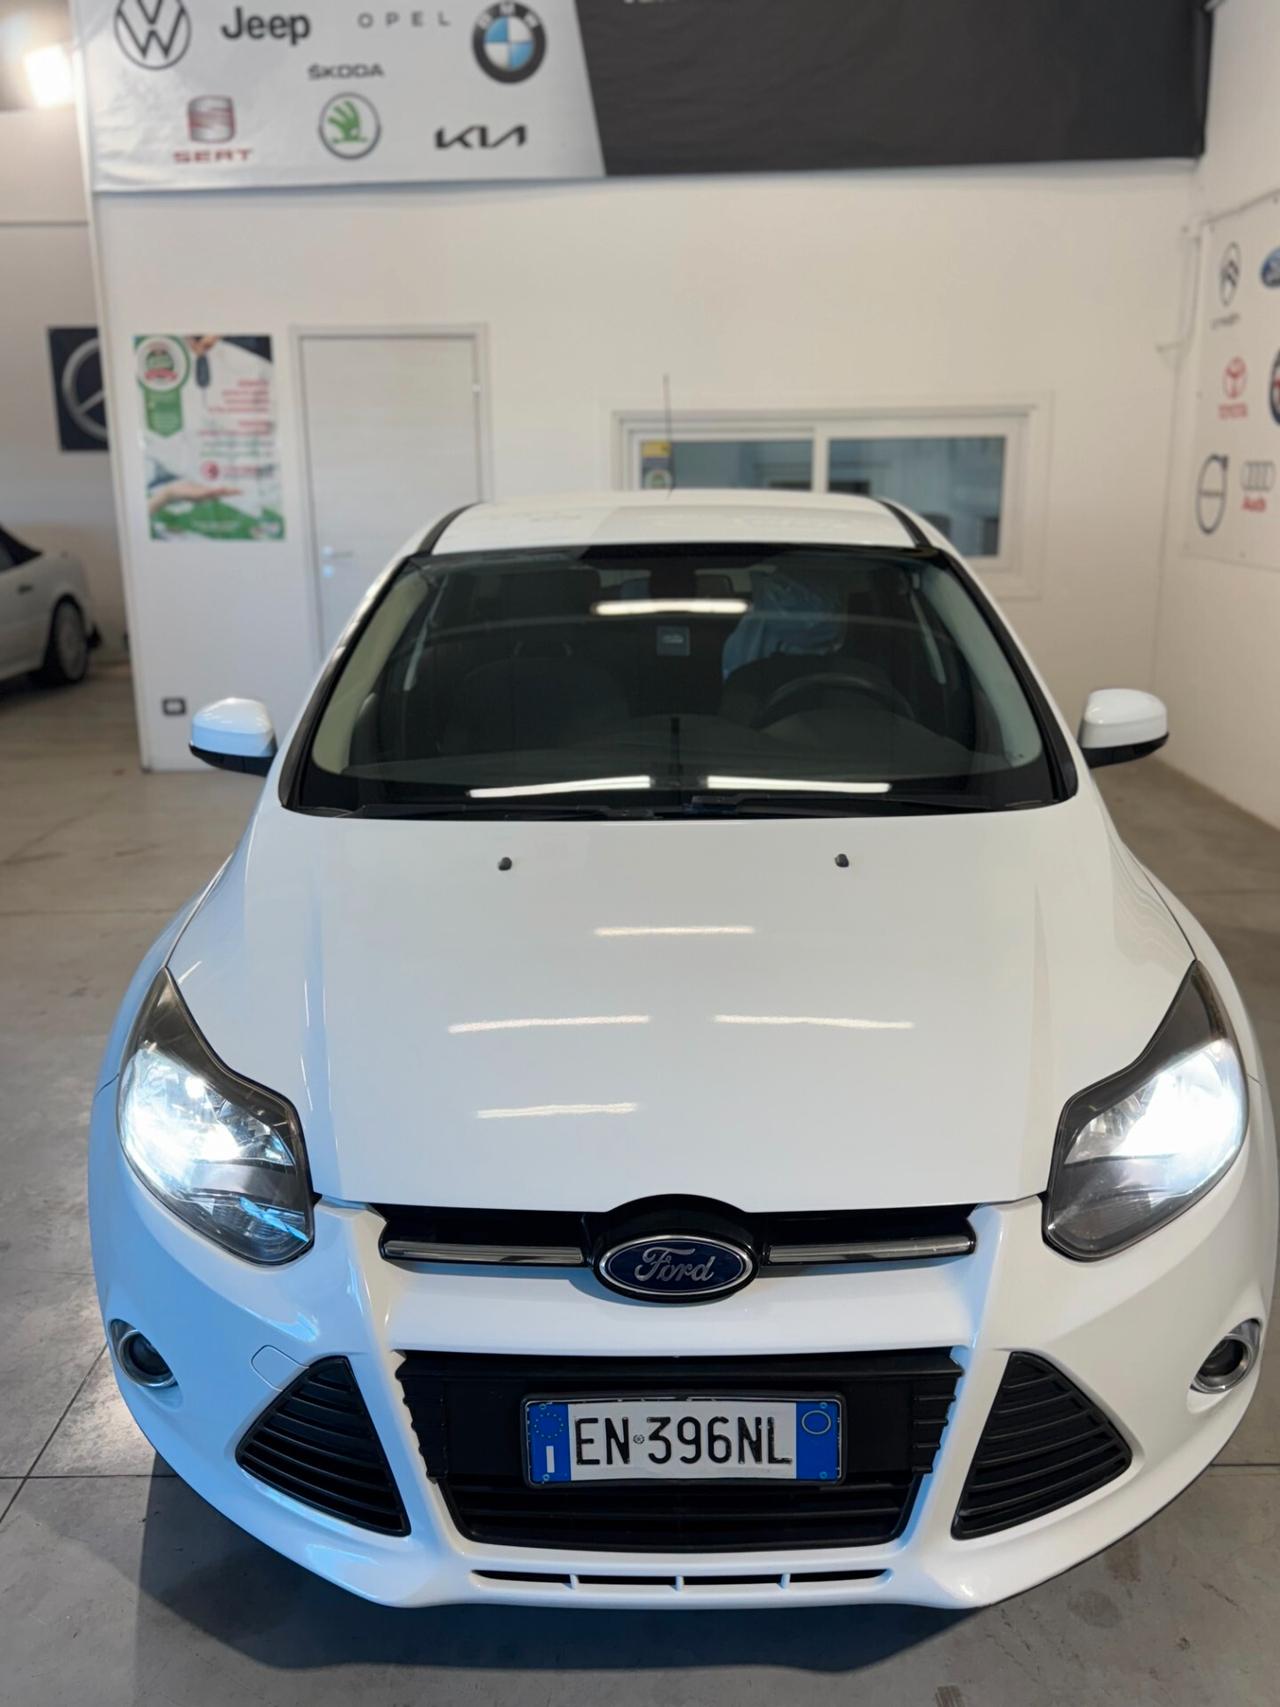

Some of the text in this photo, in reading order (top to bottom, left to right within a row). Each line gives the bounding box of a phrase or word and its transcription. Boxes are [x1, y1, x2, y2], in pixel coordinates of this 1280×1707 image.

[220, 6, 311, 46] Jeep
[357, 11, 450, 29] OPEL
[434, 123, 527, 149] KIA
[634, 1246, 715, 1282] Ford
[575, 1416, 793, 1465] EN 396NL
[546, 1445, 555, 1473] I
